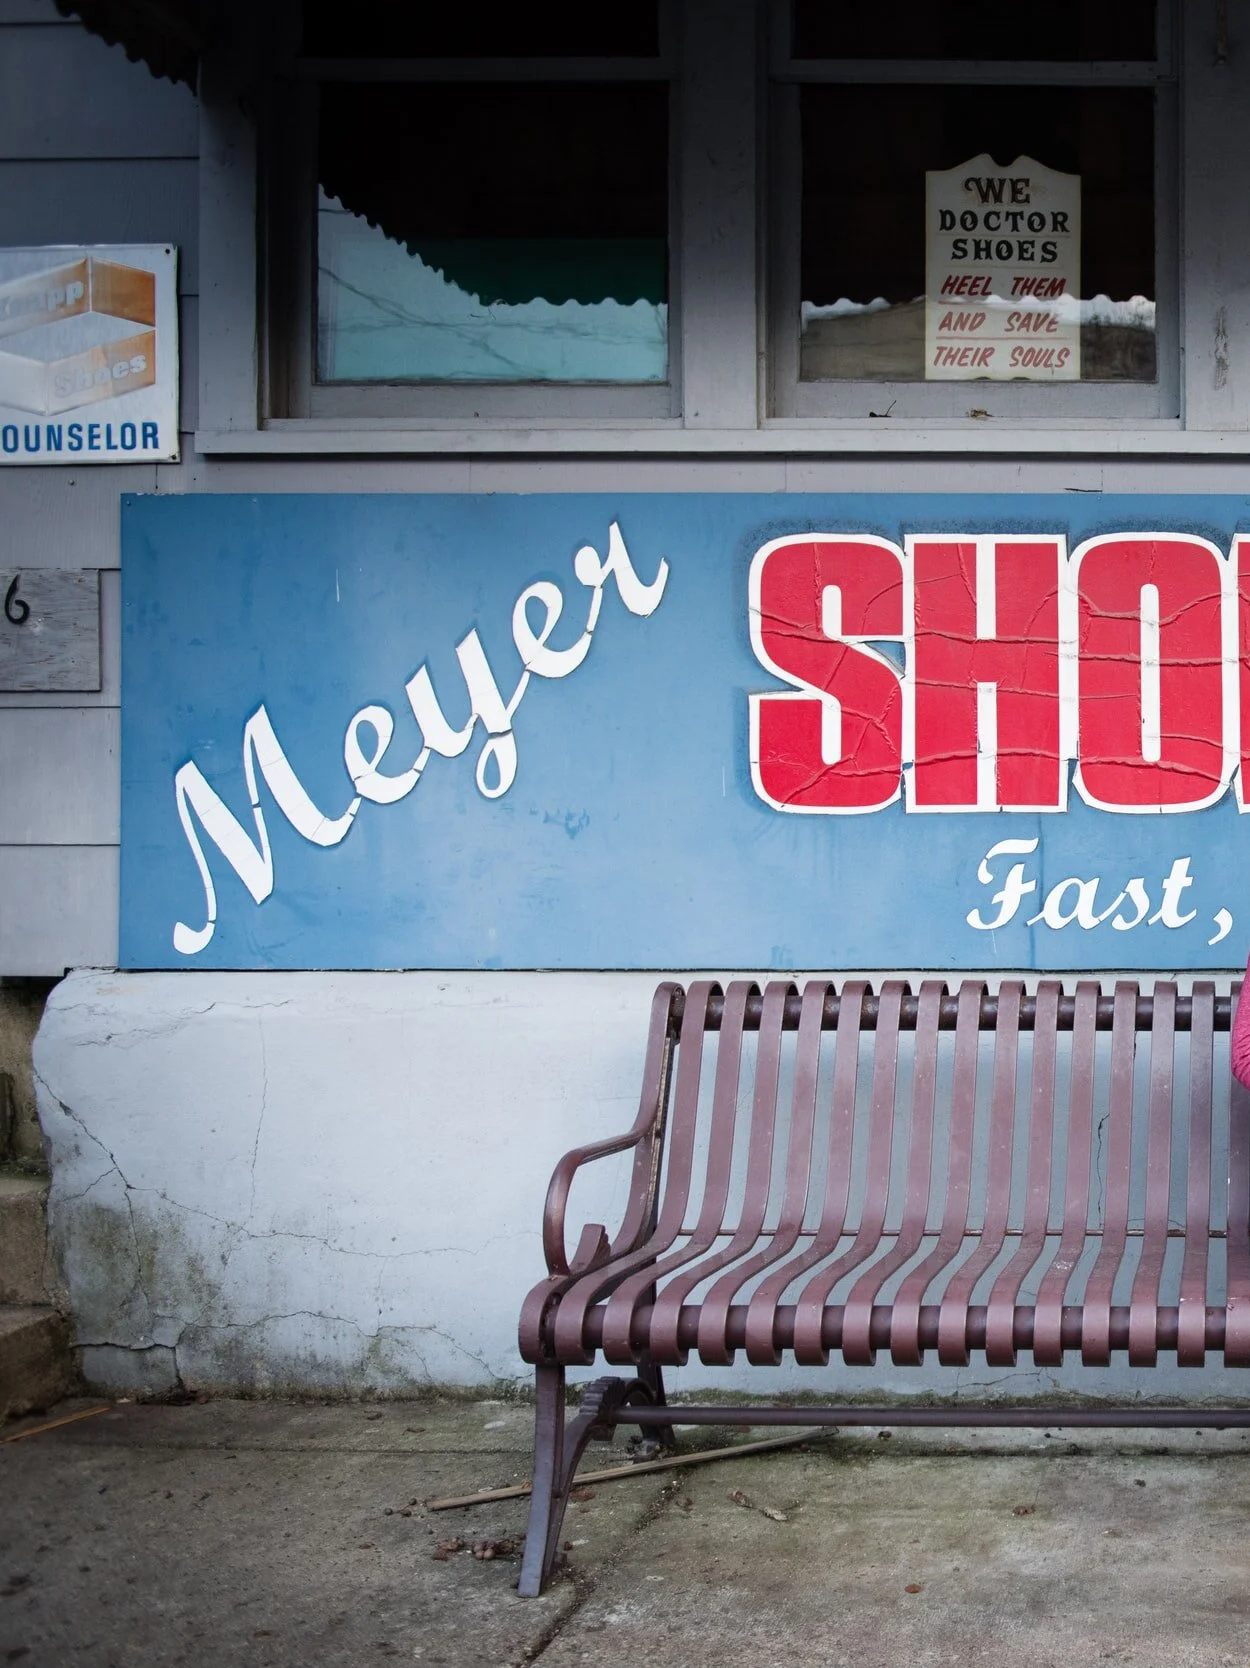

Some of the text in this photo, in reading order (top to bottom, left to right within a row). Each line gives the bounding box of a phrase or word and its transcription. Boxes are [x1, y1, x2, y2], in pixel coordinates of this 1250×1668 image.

[964, 177, 1031, 205] WE
[939, 209, 1070, 233] DOCTOR
[951, 238, 1058, 263] SHOES
[940, 275, 1067, 297] HEEL THEM
[938, 312, 1062, 333] AND SAVE
[933, 346, 1071, 369] THEIR SOULS
[4, 573, 30, 625] 6
[173, 520, 669, 955] Meyer
